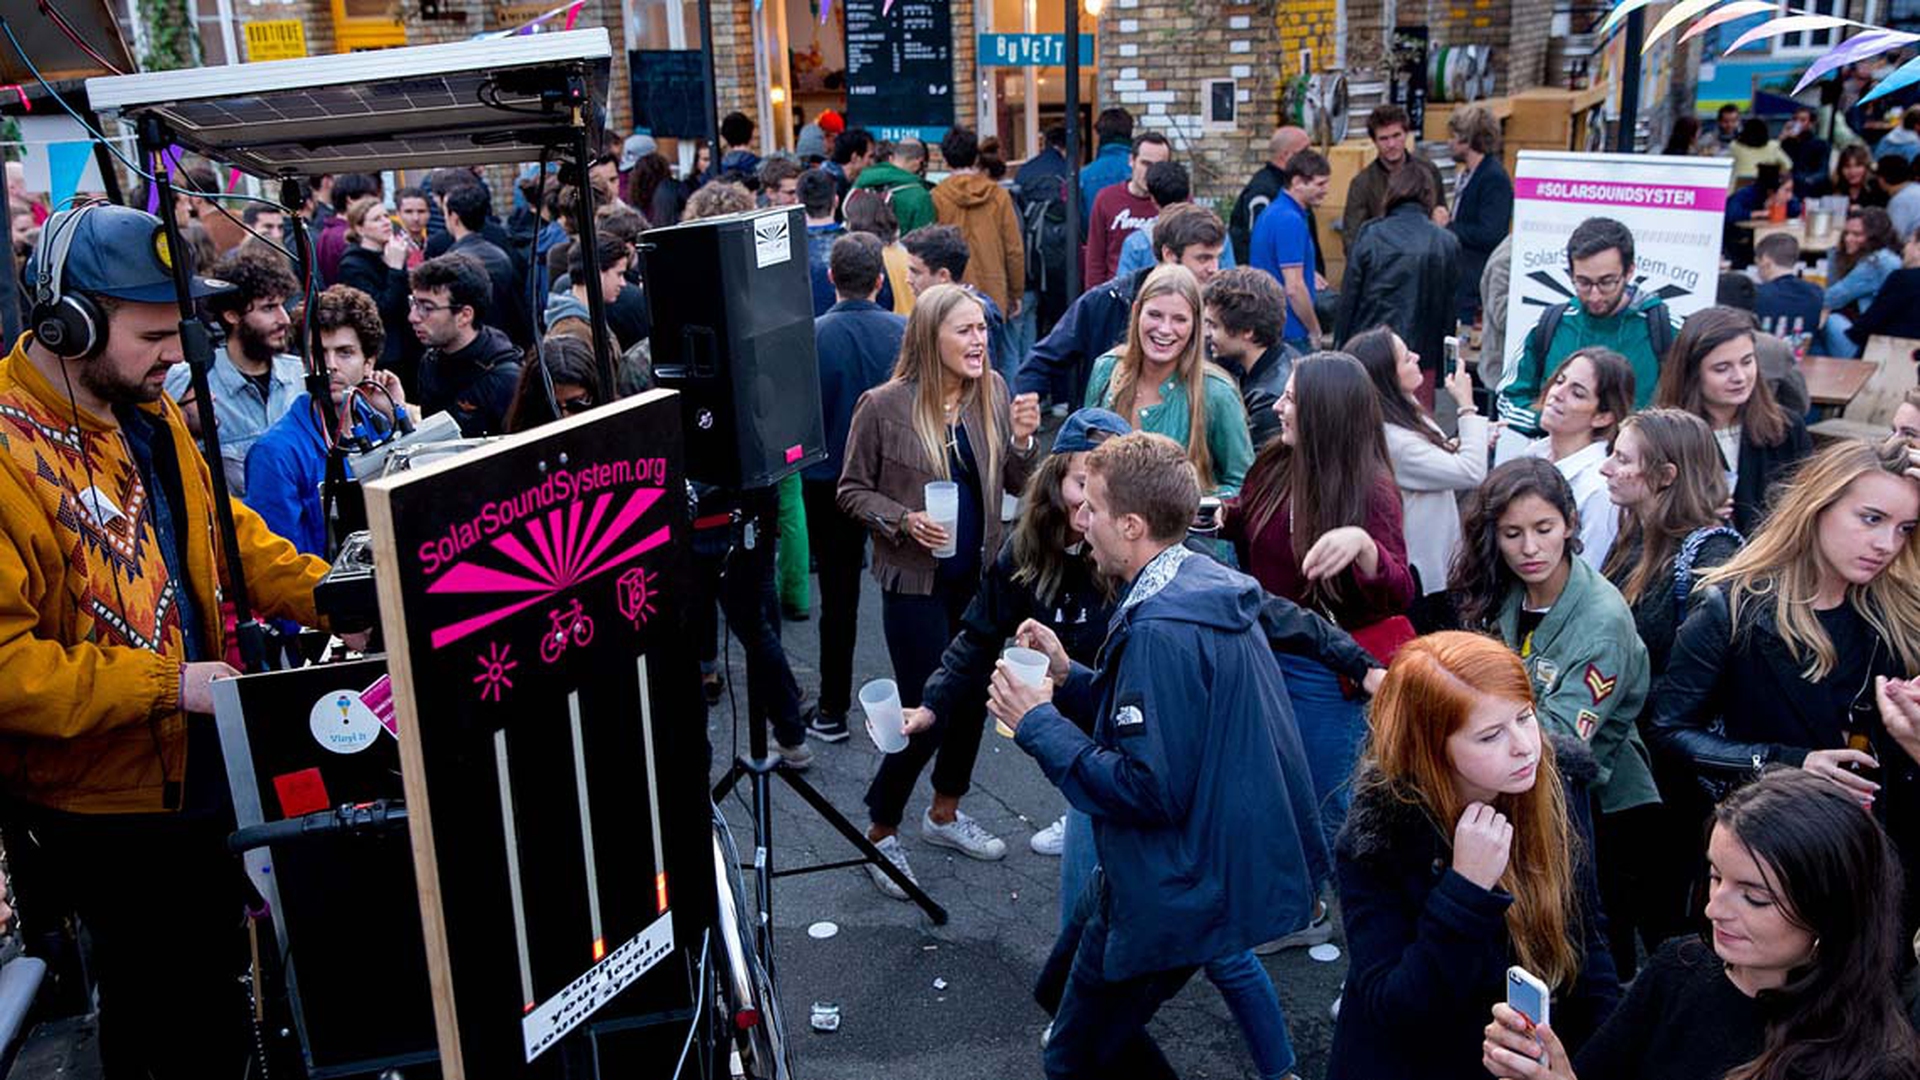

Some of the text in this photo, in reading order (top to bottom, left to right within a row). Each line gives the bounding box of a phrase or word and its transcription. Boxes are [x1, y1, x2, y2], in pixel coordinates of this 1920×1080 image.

[997, 36, 1064, 63] BUVETT
[1536, 182, 1696, 206] #SOLARSOUNDSYSTEM
[418, 457, 667, 575] SolarSoundSystem.org
[530, 942, 671, 1056] sound system
[550, 939, 651, 1025] your local
[561, 934, 640, 1000] support
